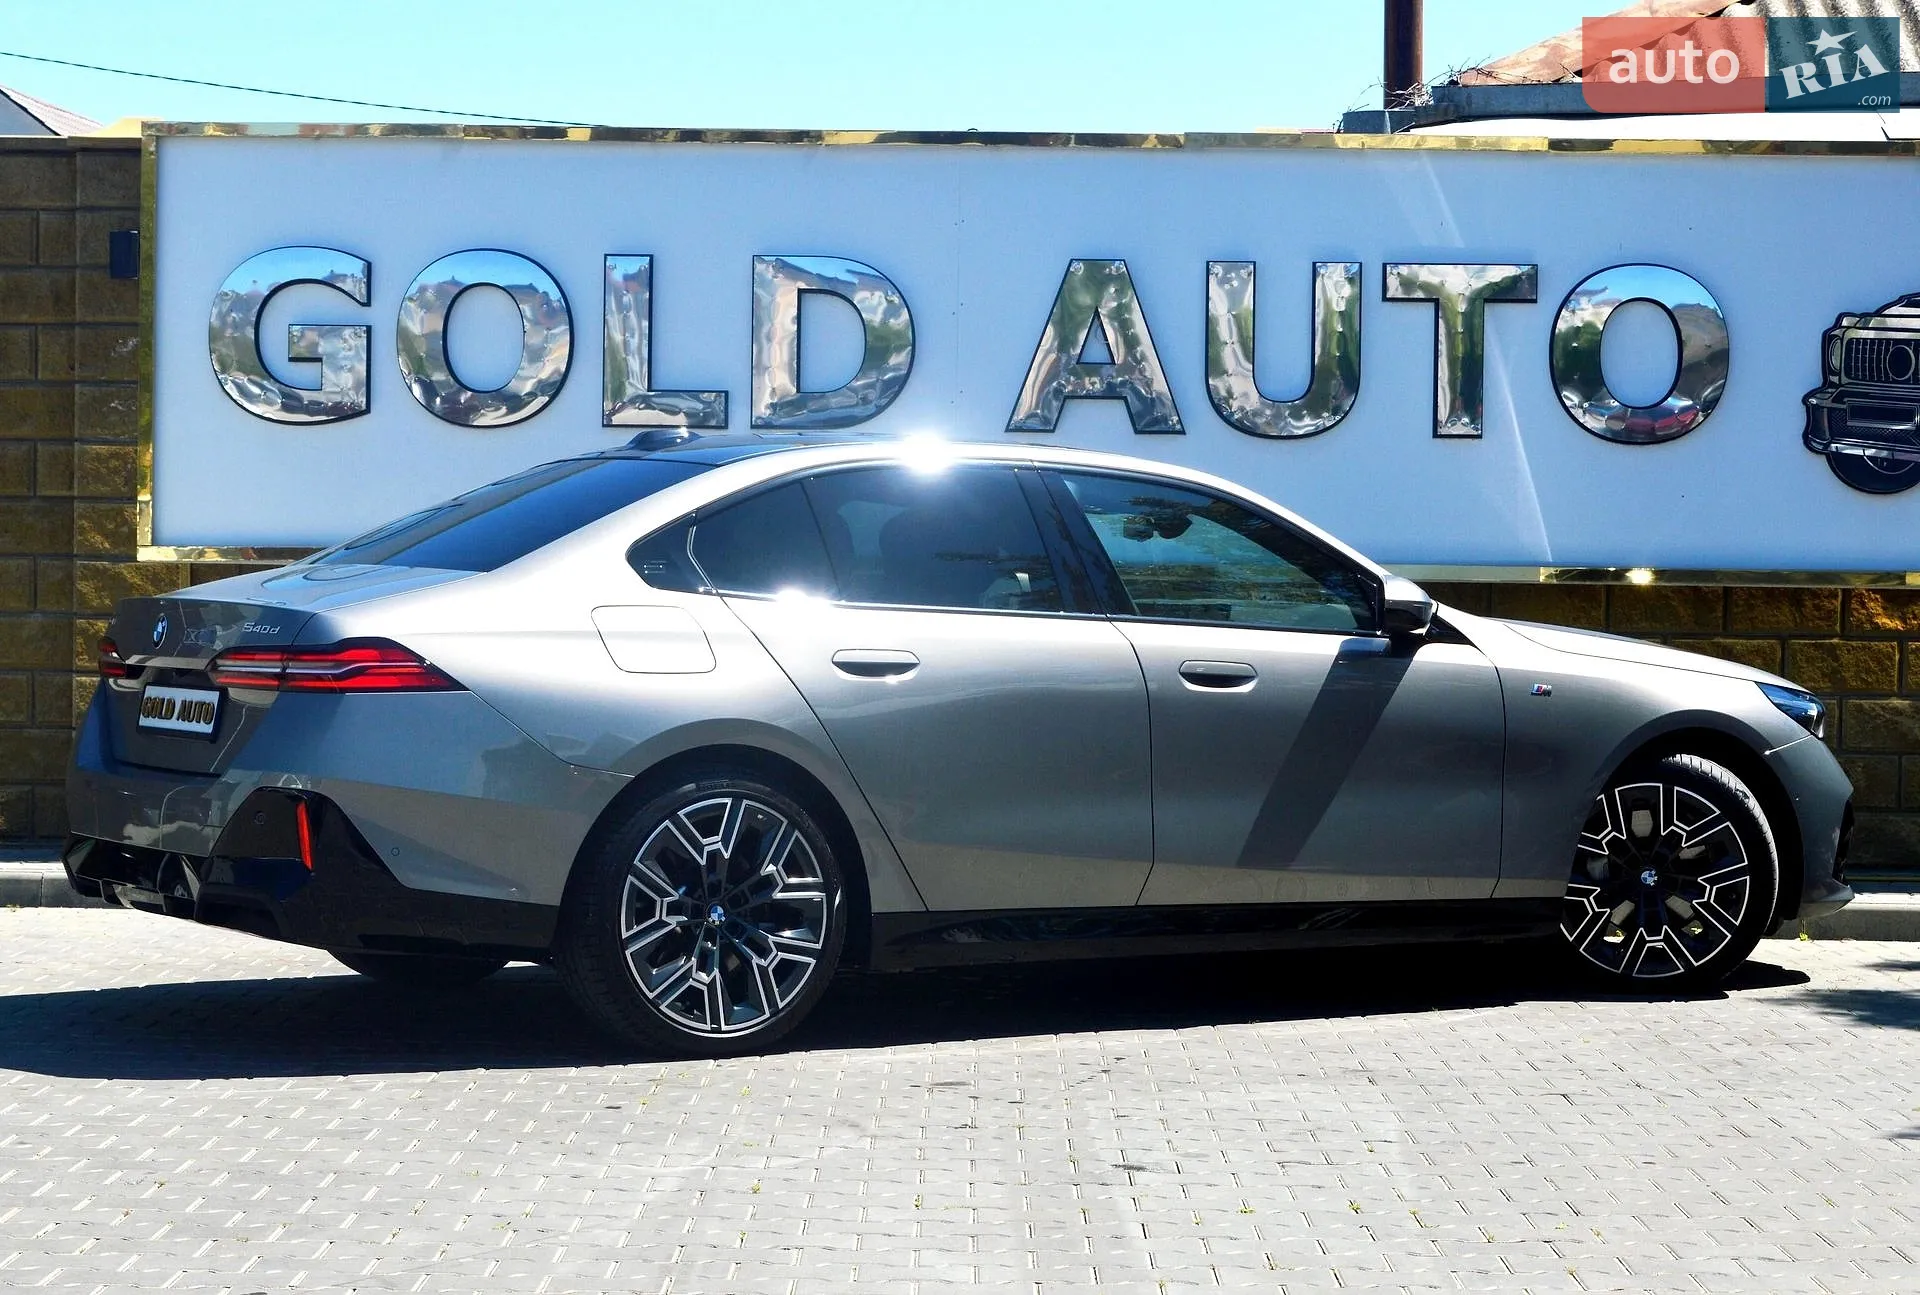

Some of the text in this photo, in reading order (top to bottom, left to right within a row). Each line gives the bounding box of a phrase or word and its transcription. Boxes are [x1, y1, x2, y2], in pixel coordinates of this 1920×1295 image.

[208, 245, 1730, 445] GOLD AUTO
[242, 622, 281, 634] 540d
[141, 696, 216, 725] GOLD AUTO
